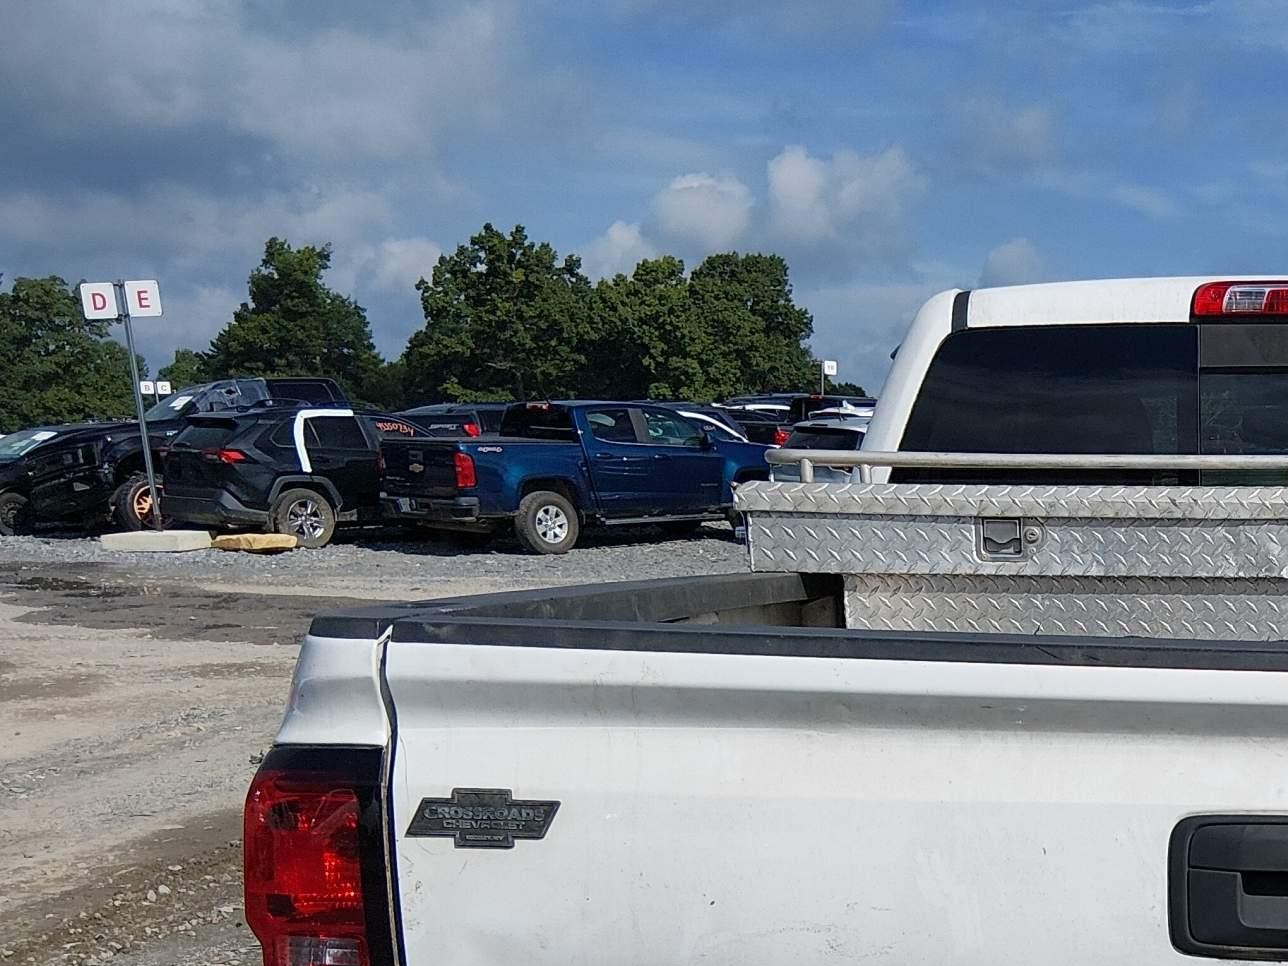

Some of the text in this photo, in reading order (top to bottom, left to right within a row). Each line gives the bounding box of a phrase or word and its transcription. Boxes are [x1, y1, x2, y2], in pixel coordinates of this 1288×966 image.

[91, 292, 107, 311] D
[137, 290, 151, 308] E
[424, 806, 545, 821] CROSSROADS
[443, 820, 526, 831] CHEVROLET
